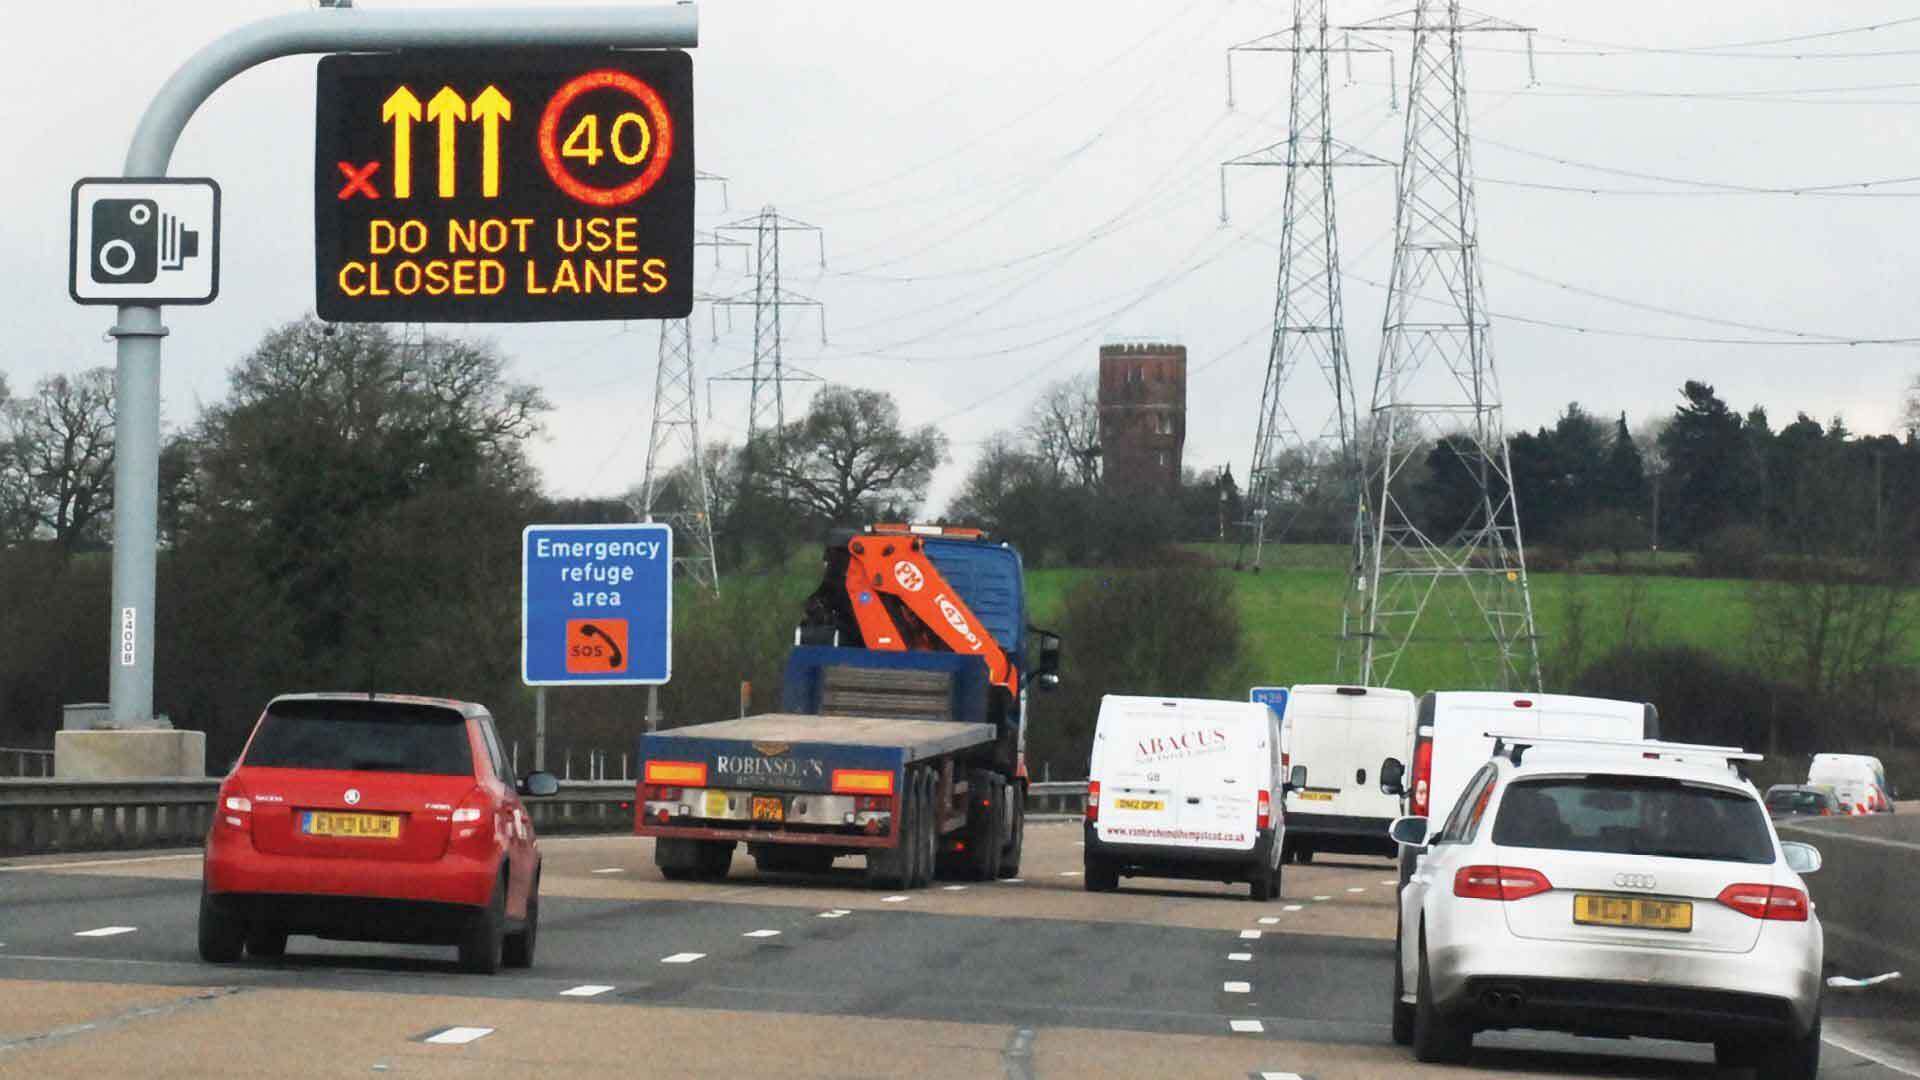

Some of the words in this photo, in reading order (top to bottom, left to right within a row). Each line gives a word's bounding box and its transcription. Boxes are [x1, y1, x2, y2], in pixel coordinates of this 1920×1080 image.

[561, 112, 651, 166] 40
[370, 220, 428, 254] DO
[448, 219, 534, 254] NOT
[557, 217, 638, 252] USE
[339, 260, 506, 296] CLOSED
[527, 258, 668, 295] LANES
[537, 538, 661, 560] Emergency
[561, 562, 635, 584] refuge
[572, 591, 622, 607] area
[571, 645, 603, 657] SOS
[1137, 729, 1226, 756] ABACUS
